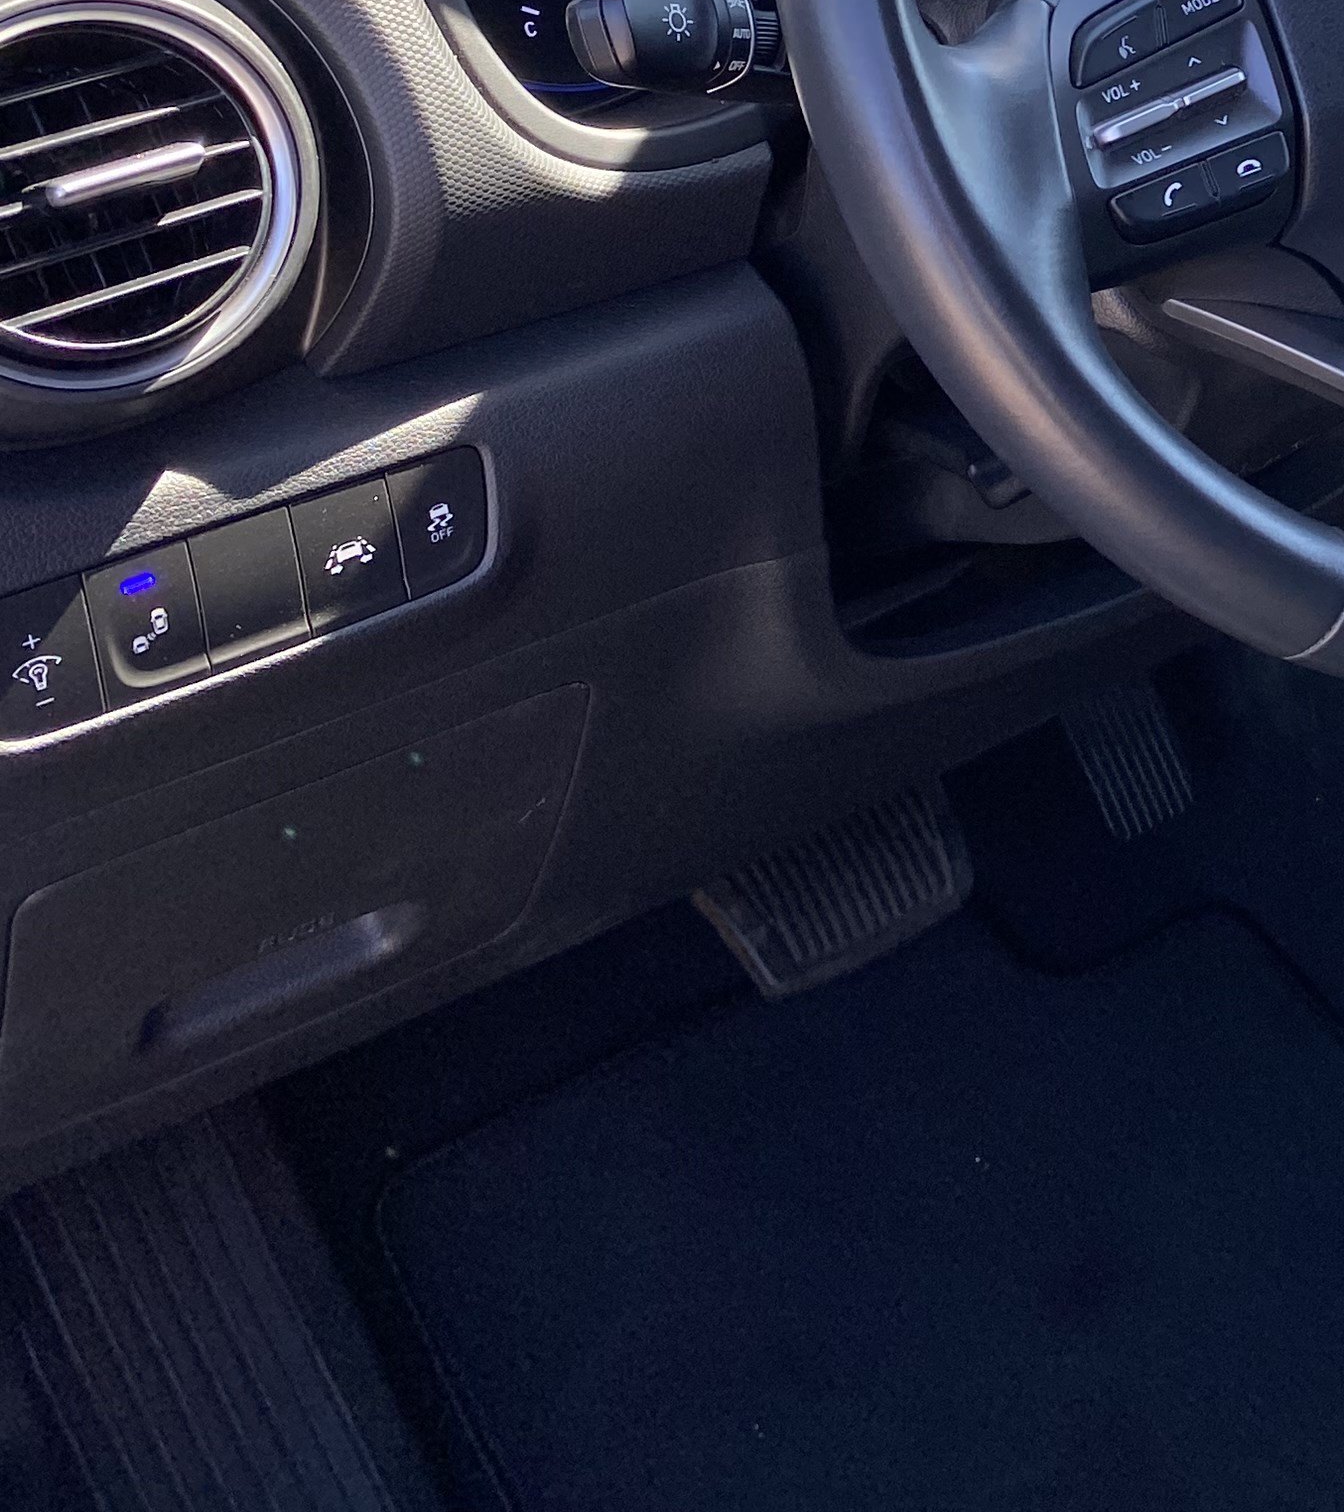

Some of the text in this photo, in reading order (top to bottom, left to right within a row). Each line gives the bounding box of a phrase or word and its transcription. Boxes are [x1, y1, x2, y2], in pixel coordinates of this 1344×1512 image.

[524, 21, 538, 37] C
[732, 29, 751, 39] AUTO
[728, 60, 746, 71] OFF
[429, 526, 455, 543] OFF
